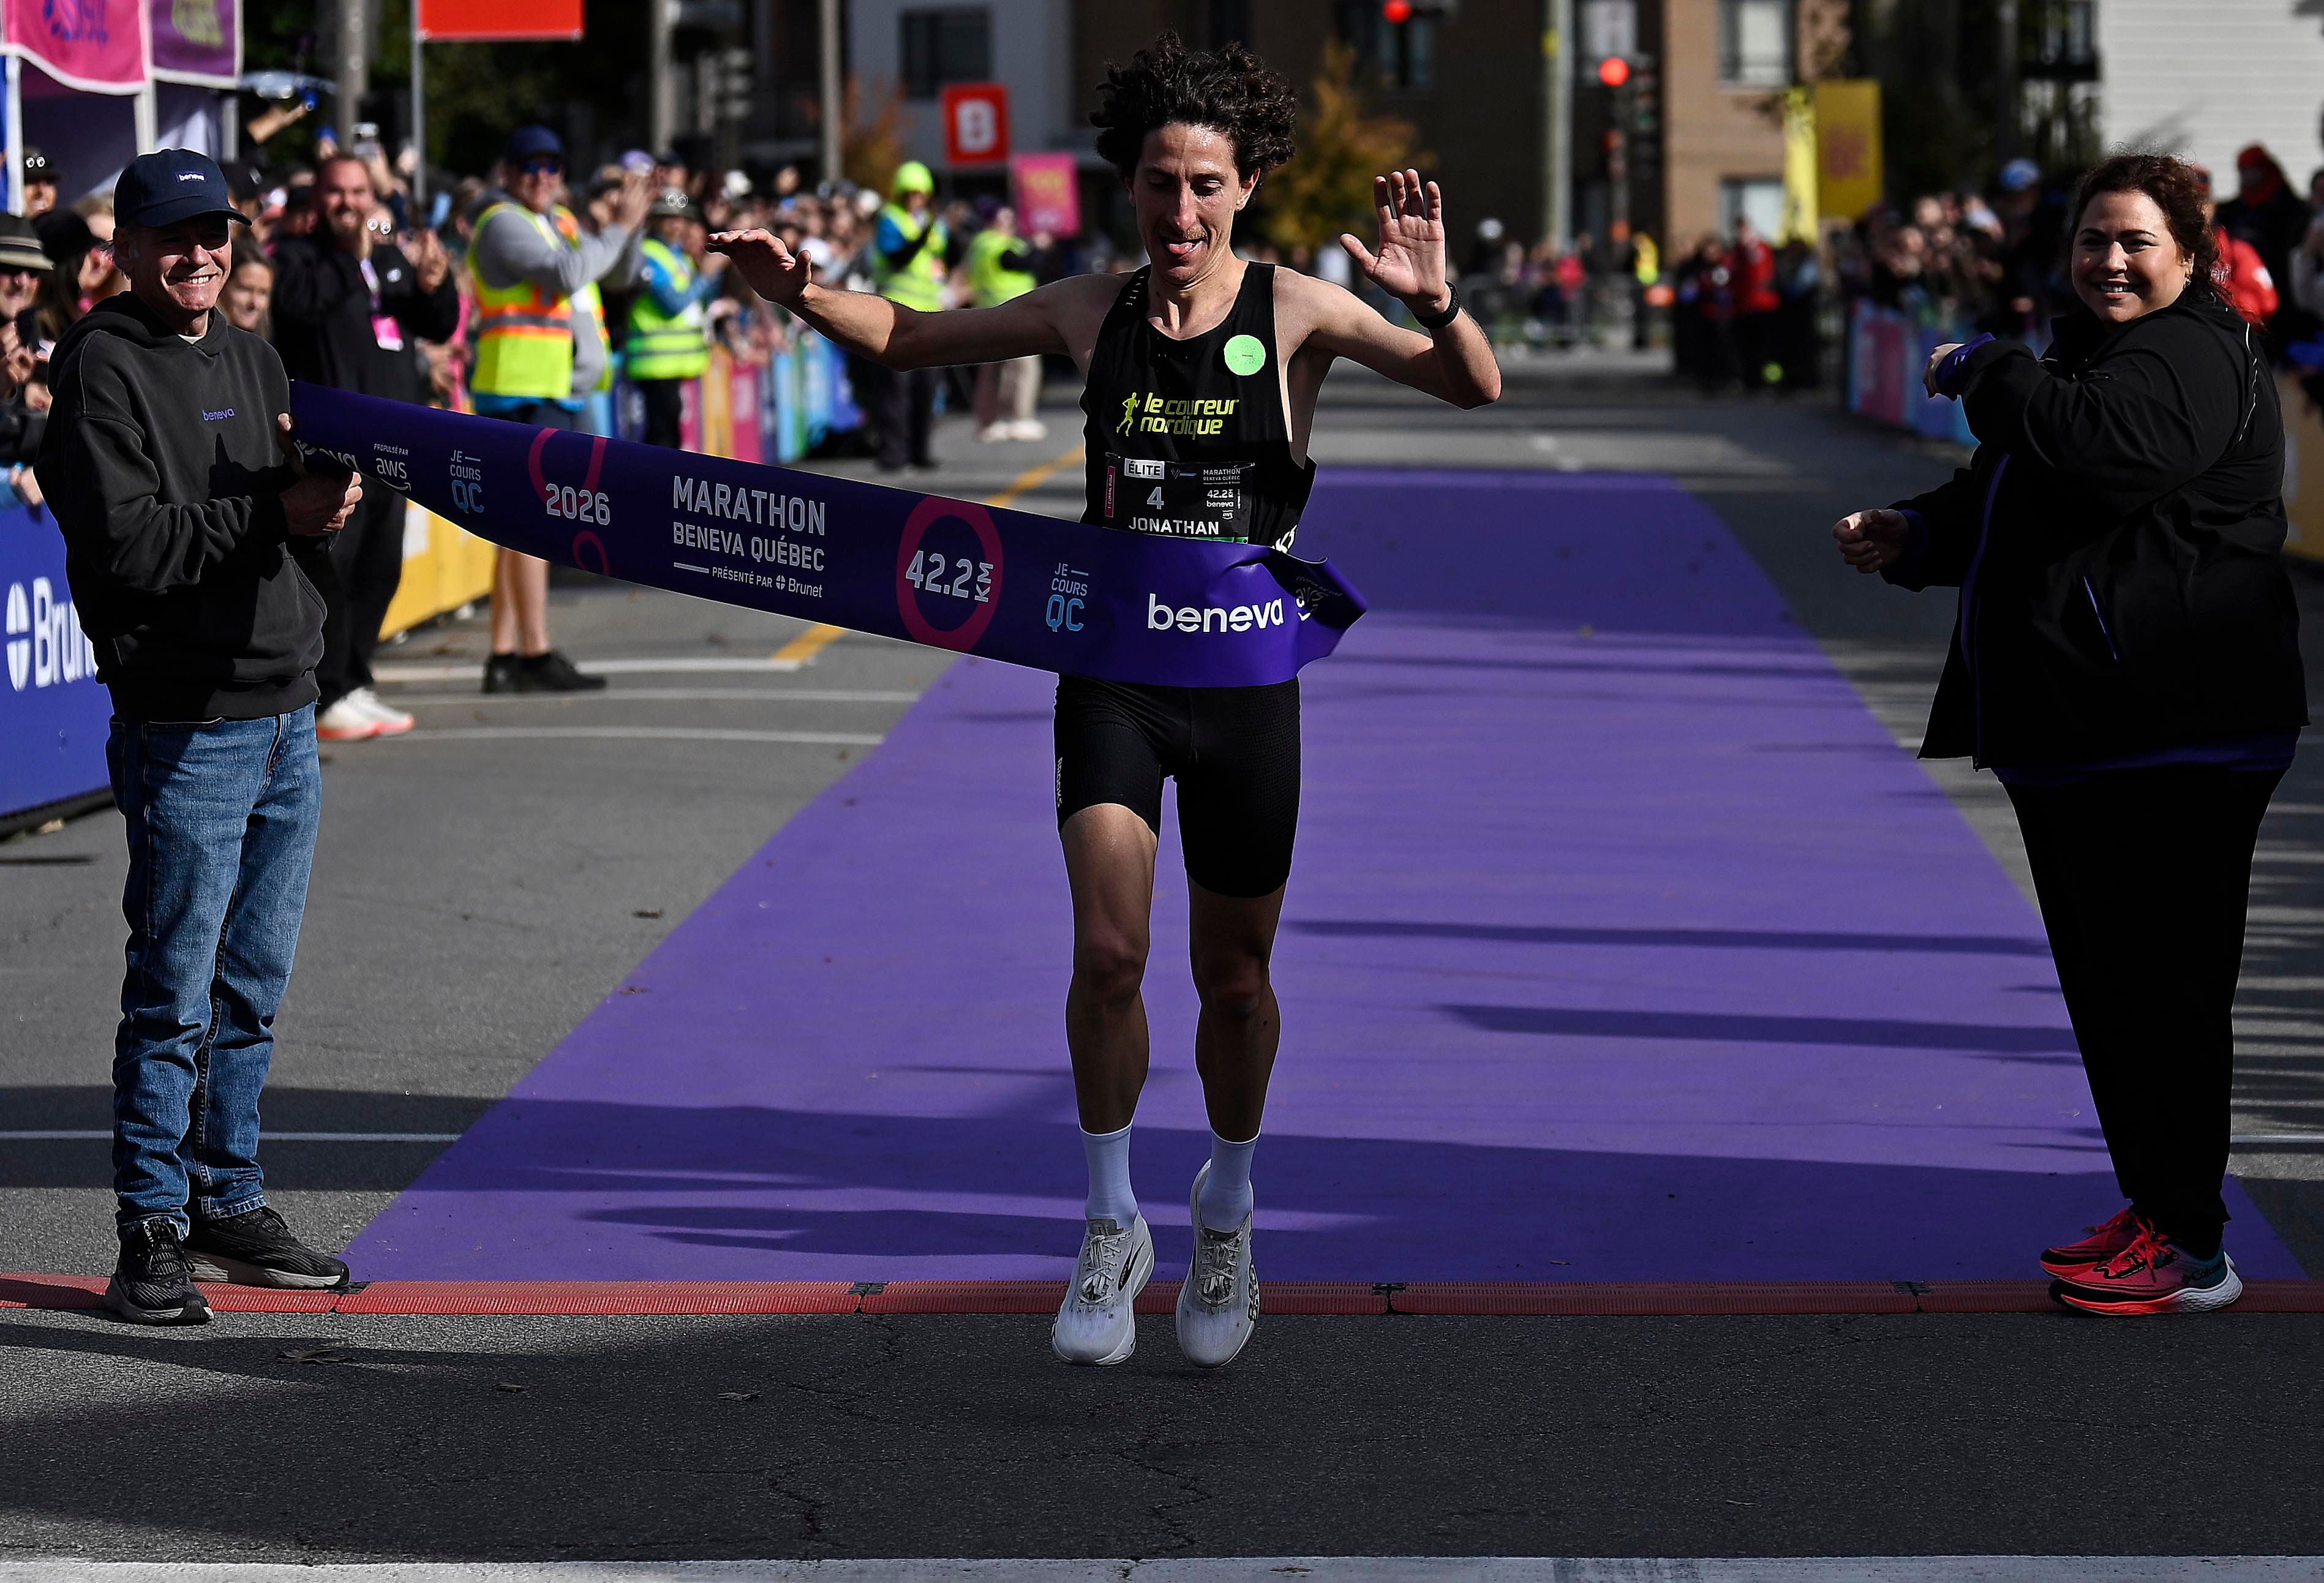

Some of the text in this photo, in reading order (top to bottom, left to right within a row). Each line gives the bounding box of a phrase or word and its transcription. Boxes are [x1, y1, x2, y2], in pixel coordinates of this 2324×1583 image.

[956, 99, 996, 151] B
[202, 408, 235, 421] beneva
[1144, 393, 1239, 415] le coureur
[1140, 416, 1223, 440] nordique
[450, 449, 462, 463] JE
[375, 457, 407, 479] aws
[449, 464, 481, 481] COURS
[1129, 461, 1161, 476] ÉLITE
[451, 479, 485, 514] QC
[545, 483, 611, 526] 2026
[1147, 486, 1164, 509] 4
[1207, 489, 1228, 498] 42.2
[674, 475, 825, 536] MARATHON
[1129, 517, 1219, 535] JONATHAN
[674, 522, 825, 572] BENEVA QUÉBEC
[905, 550, 994, 603] 42.2 KM
[1054, 562, 1069, 577] JE
[712, 566, 824, 598] PRÉSENTÉ PAR Brunet
[1051, 577, 1088, 597] COURS
[1045, 594, 1085, 633] QC
[1148, 593, 1284, 633] beneva
[34, 576, 99, 688] Brun
